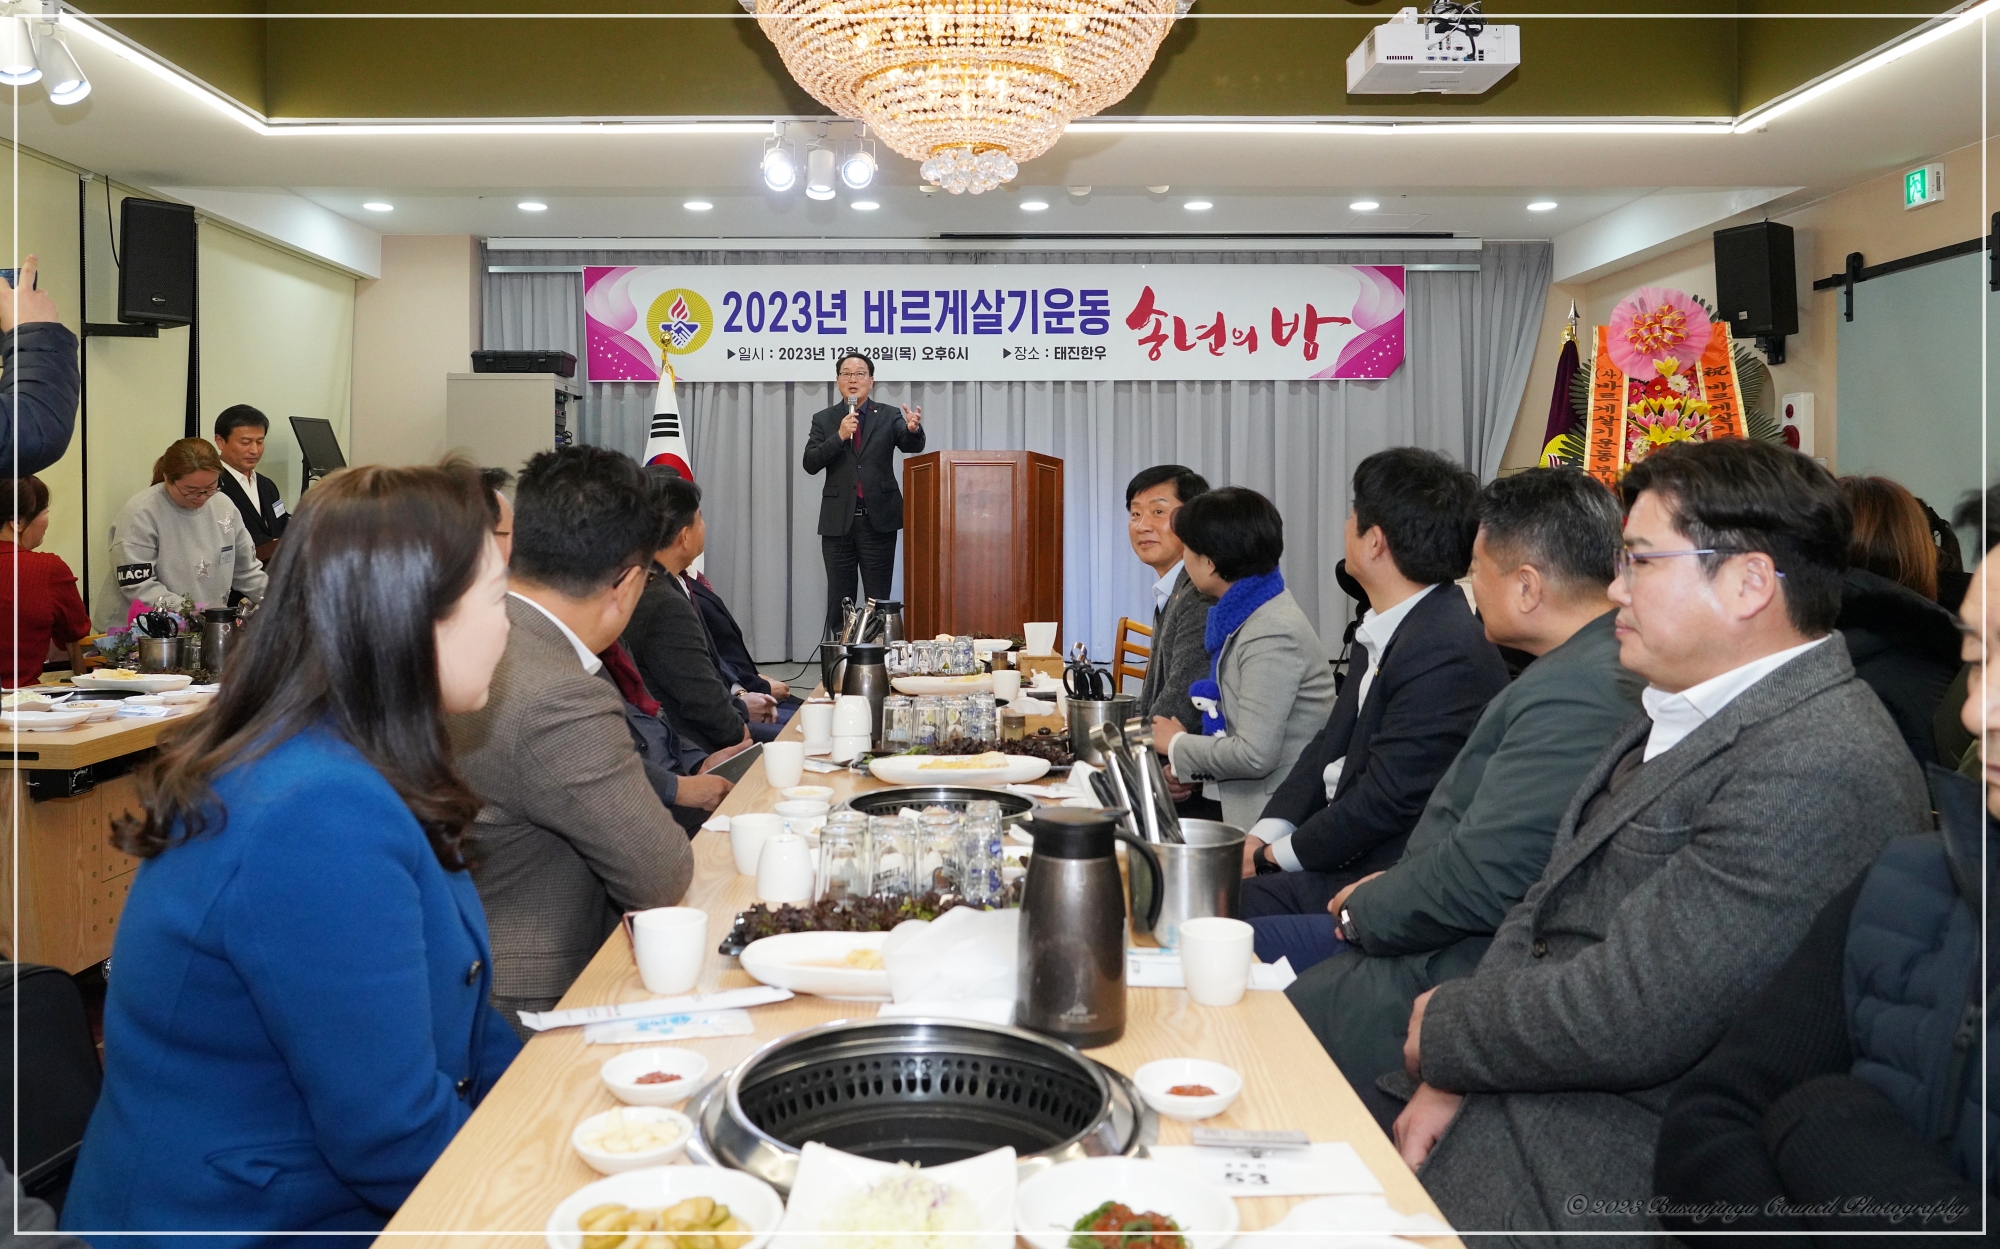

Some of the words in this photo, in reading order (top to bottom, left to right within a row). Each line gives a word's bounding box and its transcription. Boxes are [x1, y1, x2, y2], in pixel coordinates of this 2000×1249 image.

[723, 289, 847, 335] 2023년
[864, 287, 1111, 336] 바르게살기운동
[1125, 285, 1259, 361] 송년의
[1271, 303, 1351, 361] 밤
[738, 346, 765, 361] 일시
[778, 346, 826, 361] 2023년
[863, 346, 917, 361] 28일(목)
[921, 346, 969, 361] 오후6시
[1014, 346, 1040, 361] 장소
[1054, 346, 1107, 361] 태진한우
[1705, 381, 1738, 438] 바르게살기
